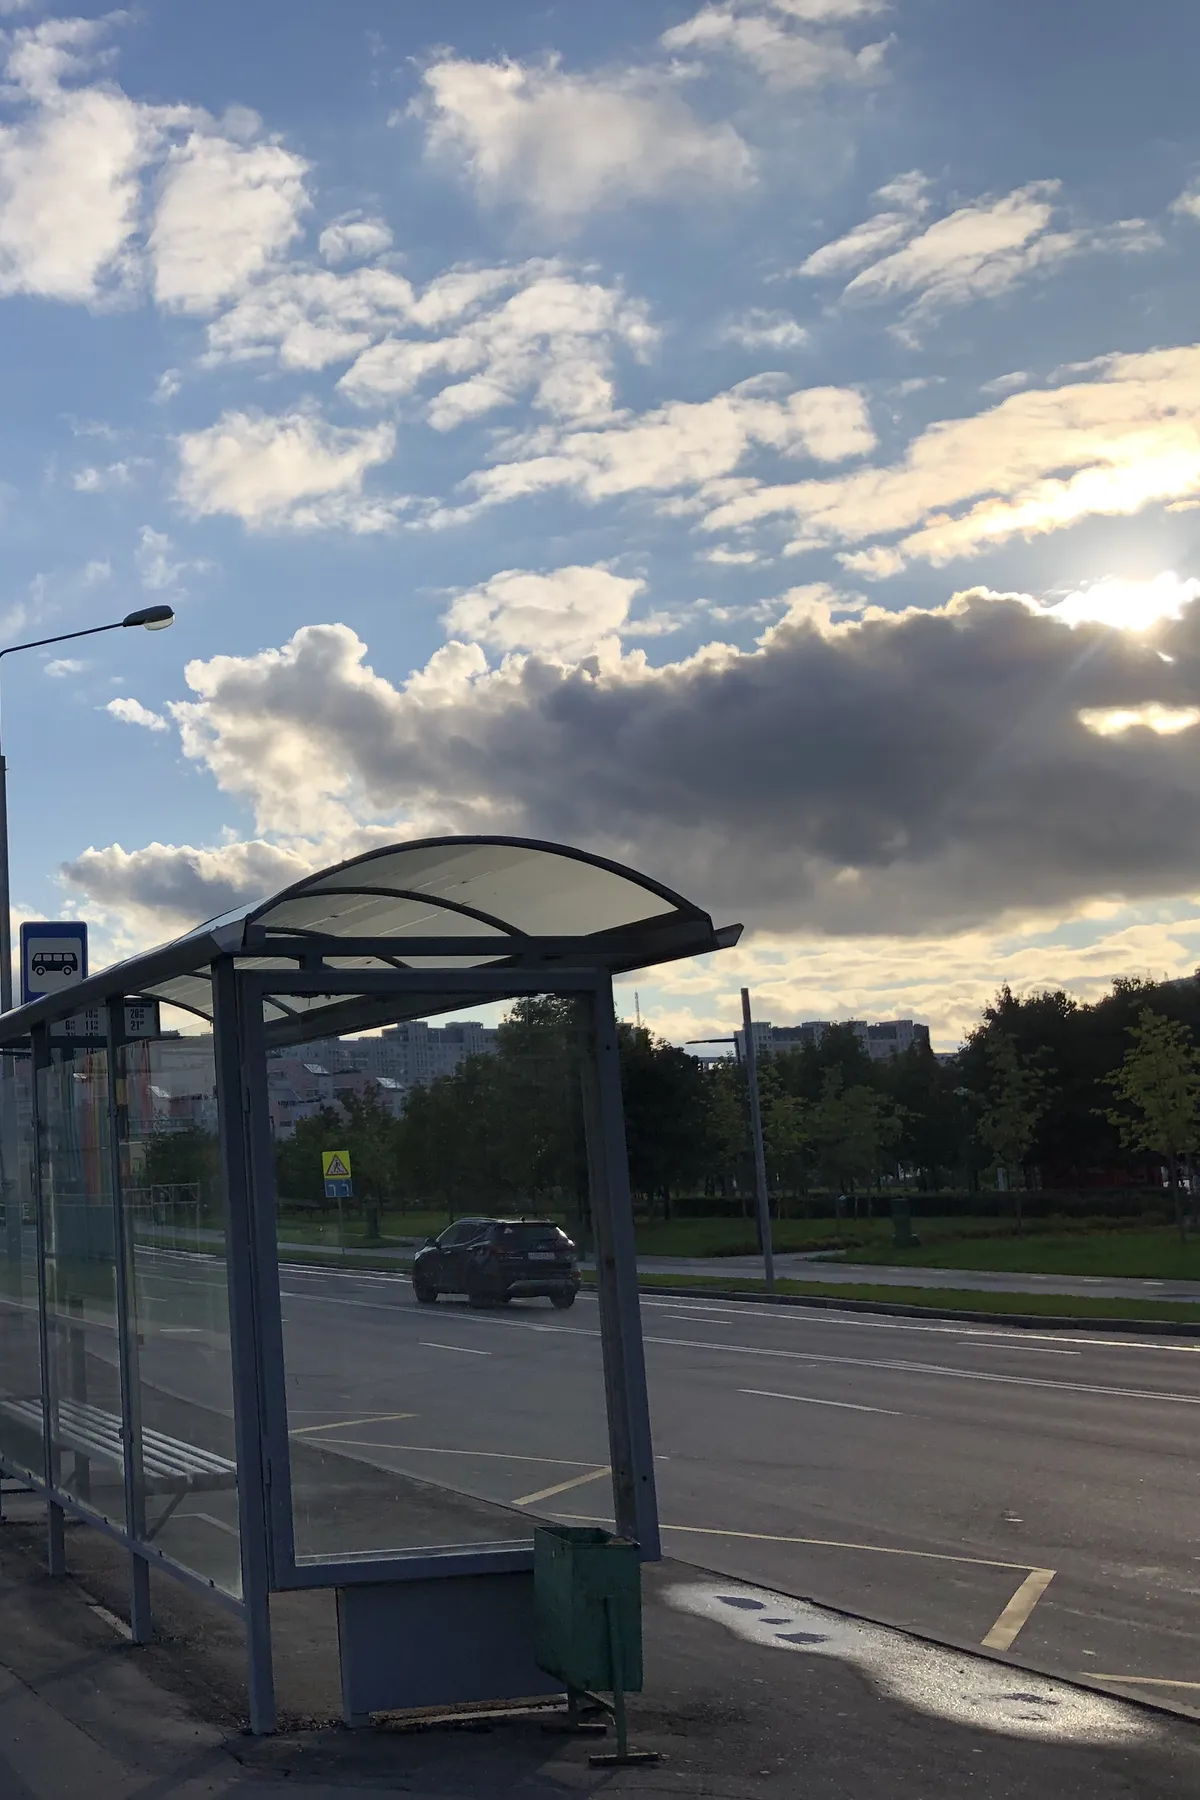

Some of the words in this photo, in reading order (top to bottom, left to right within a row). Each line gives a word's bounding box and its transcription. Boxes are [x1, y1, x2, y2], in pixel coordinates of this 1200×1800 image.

[130, 1008, 139, 1019] 20
[85, 1020, 93, 1031] 11
[130, 1020, 140, 1031] 21
